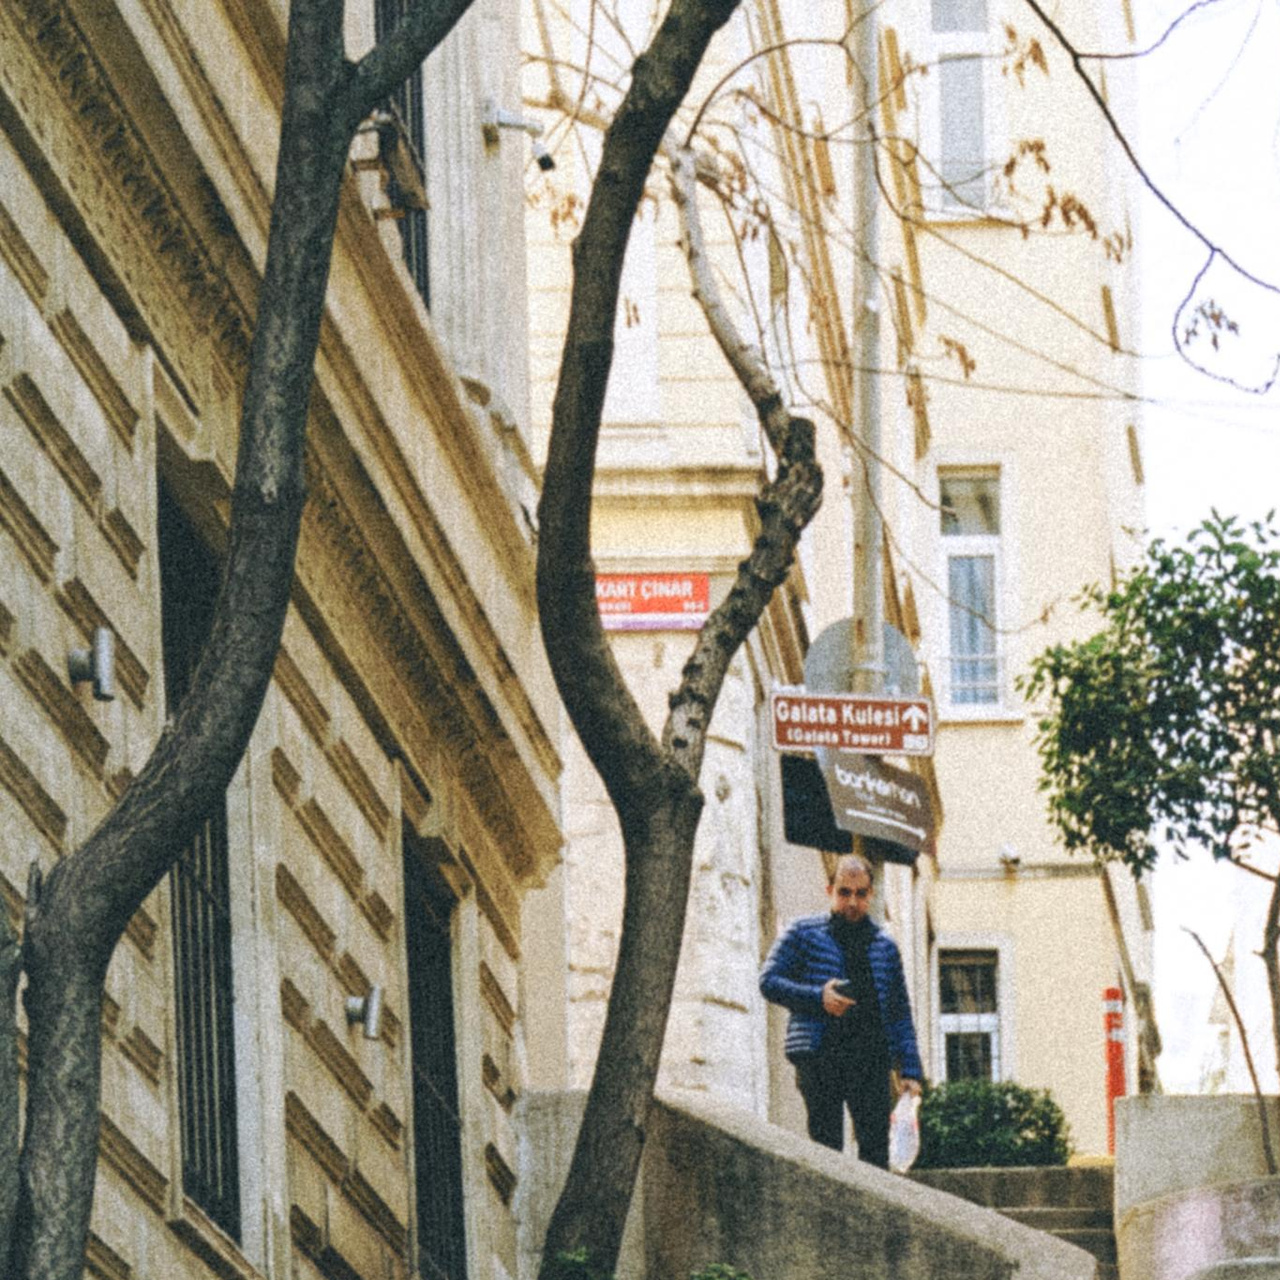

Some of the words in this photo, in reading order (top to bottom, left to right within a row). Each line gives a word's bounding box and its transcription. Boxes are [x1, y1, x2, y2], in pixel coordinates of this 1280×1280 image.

[776, 701, 837, 724] Galata
[842, 703, 900, 726] Kulesi
[787, 728, 839, 743] (Galata
